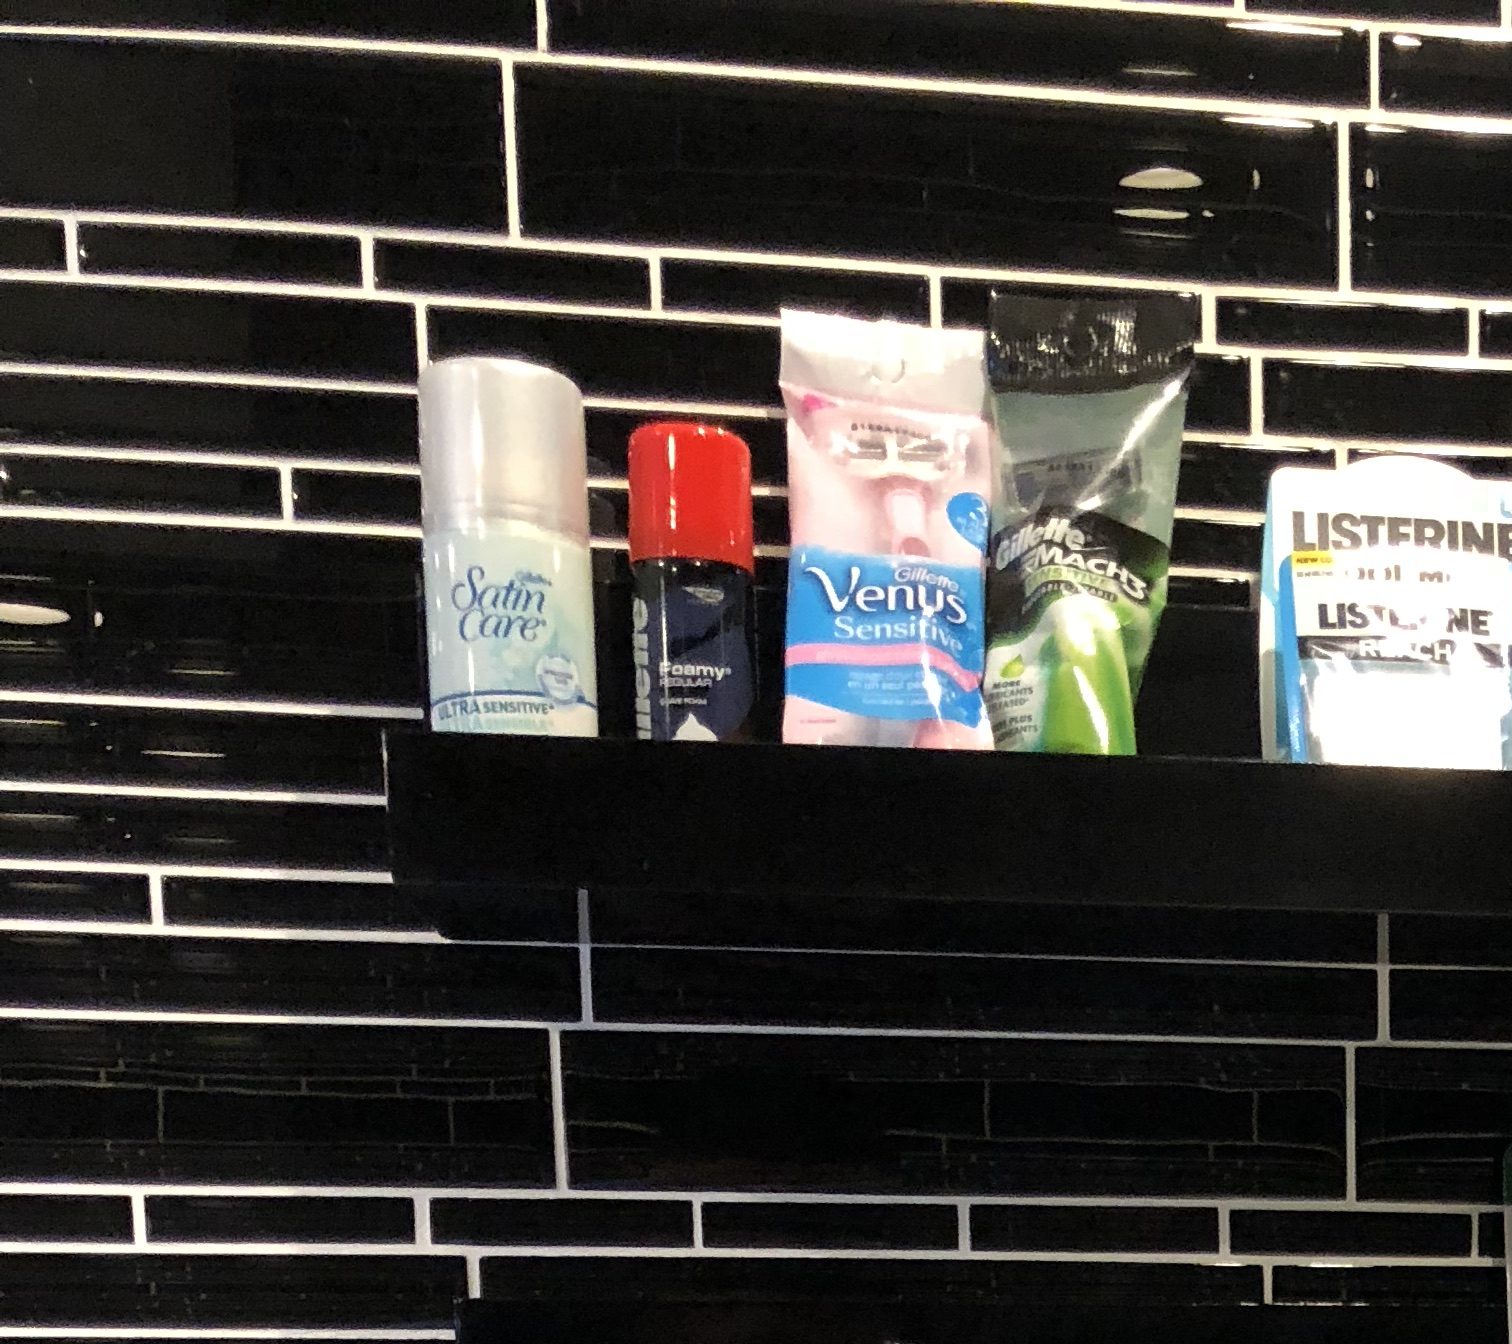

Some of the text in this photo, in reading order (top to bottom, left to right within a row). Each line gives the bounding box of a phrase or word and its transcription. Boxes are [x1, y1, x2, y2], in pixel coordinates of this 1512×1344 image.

[995, 518, 1086, 571] Gillette
[452, 566, 545, 614] Satin
[895, 567, 960, 592] Gillette
[1037, 546, 1148, 600] MACH3
[805, 566, 967, 624] Venus
[459, 609, 540, 642] Care
[834, 615, 963, 651] Sensitive
[659, 662, 728, 681] Foamy
[483, 701, 549, 715] SENSITIVE
